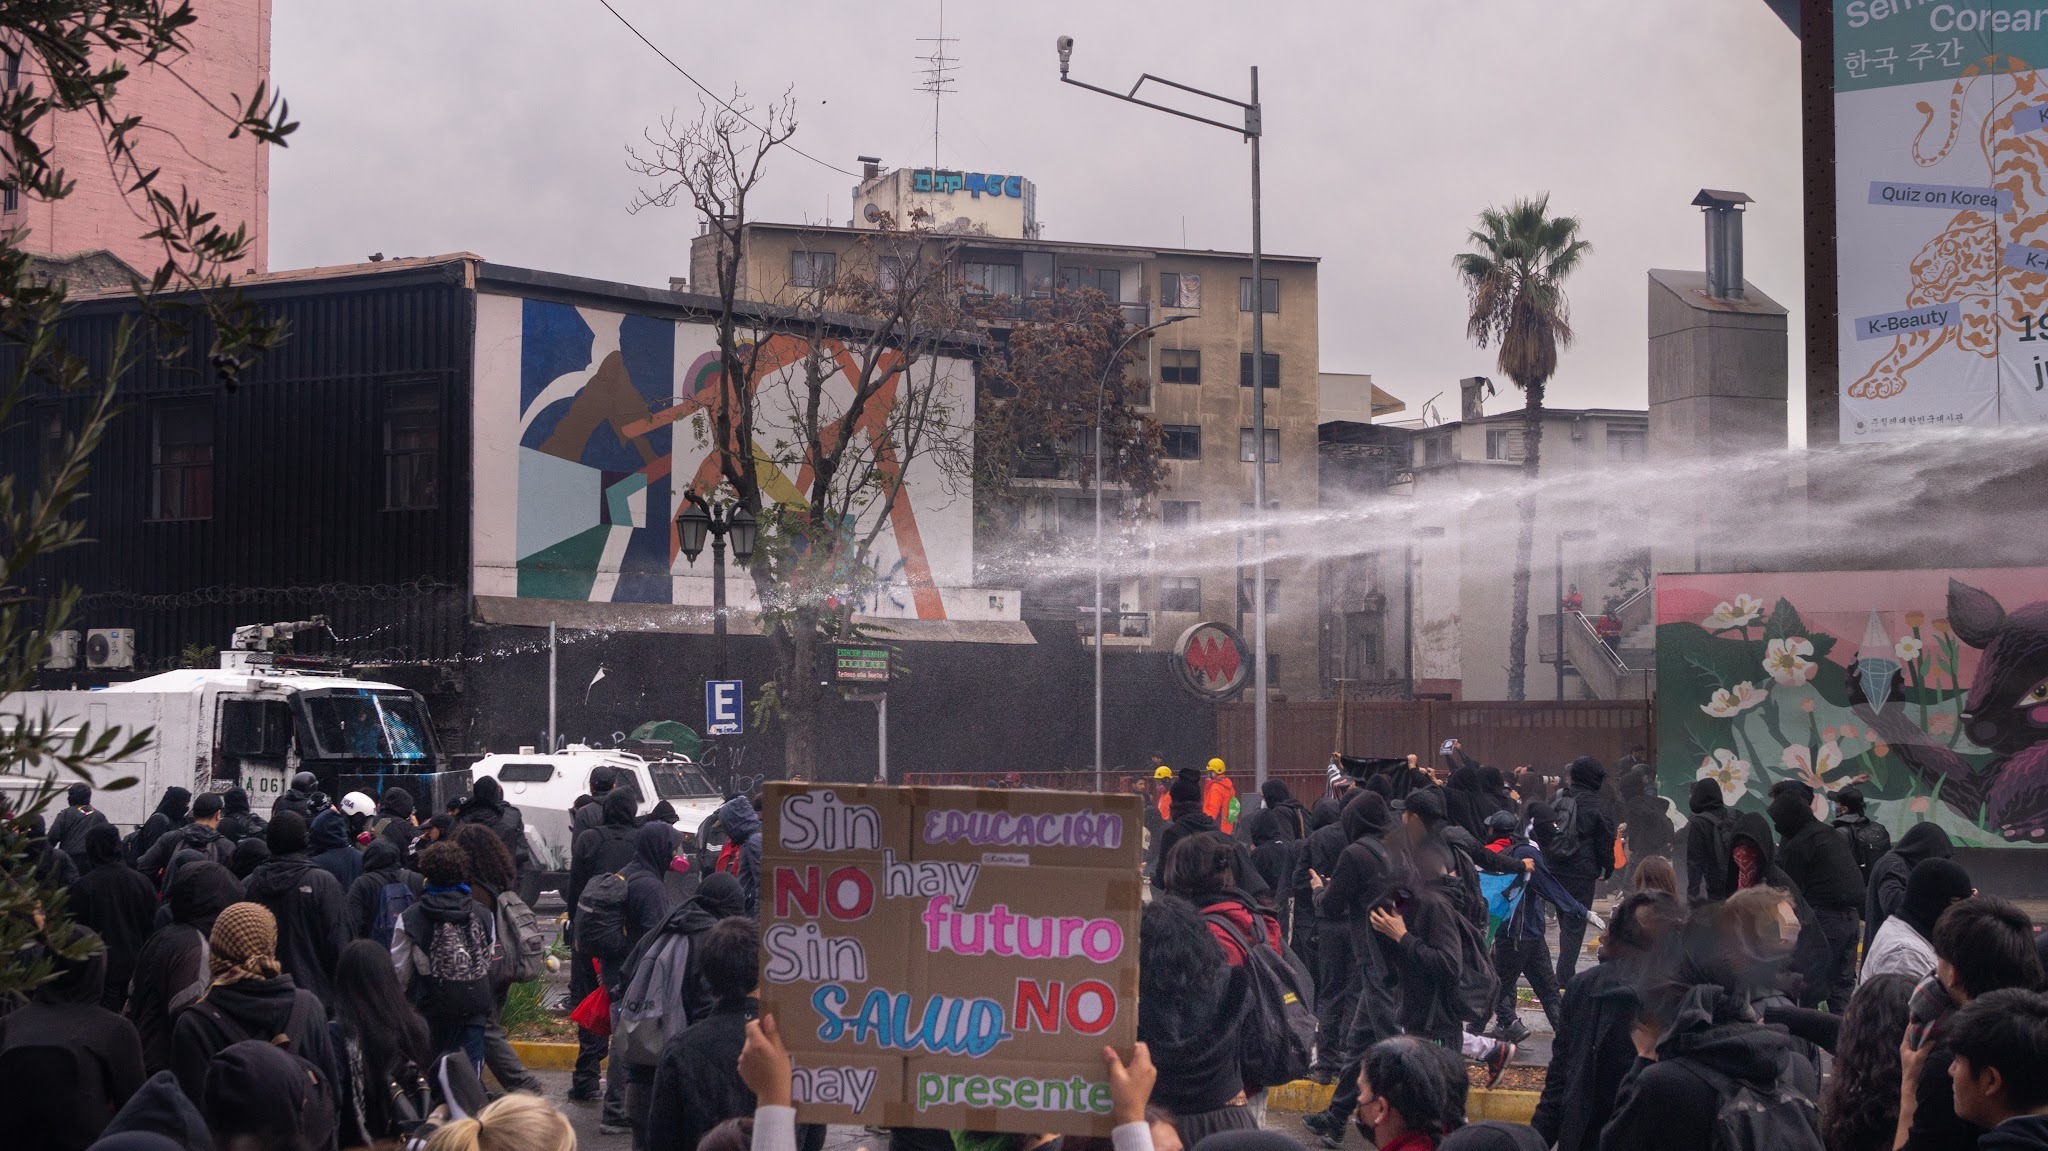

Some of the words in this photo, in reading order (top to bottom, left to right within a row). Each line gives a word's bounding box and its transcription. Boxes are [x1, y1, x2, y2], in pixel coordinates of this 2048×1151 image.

[1846, 0, 1935, 28] Se
[1843, 47, 1899, 79] 한국
[1907, 37, 1965, 71] 주간
[1882, 186, 1921, 202] Quiz
[1925, 191, 1947, 204] on
[1951, 190, 1998, 207] Korea
[2025, 252, 2048, 270] K-
[1868, 310, 1948, 334] K-Beauty
[2033, 355, 2048, 391] j
[715, 684, 735, 720] E
[260, 778, 286, 795] 061
[780, 791, 882, 852] Sin
[775, 866, 875, 921] NO
[882, 849, 979, 907] hay
[923, 896, 1123, 963] futuro
[765, 924, 867, 982] Sin
[1014, 979, 1117, 1035] NO
[918, 1072, 1113, 1113] presente
